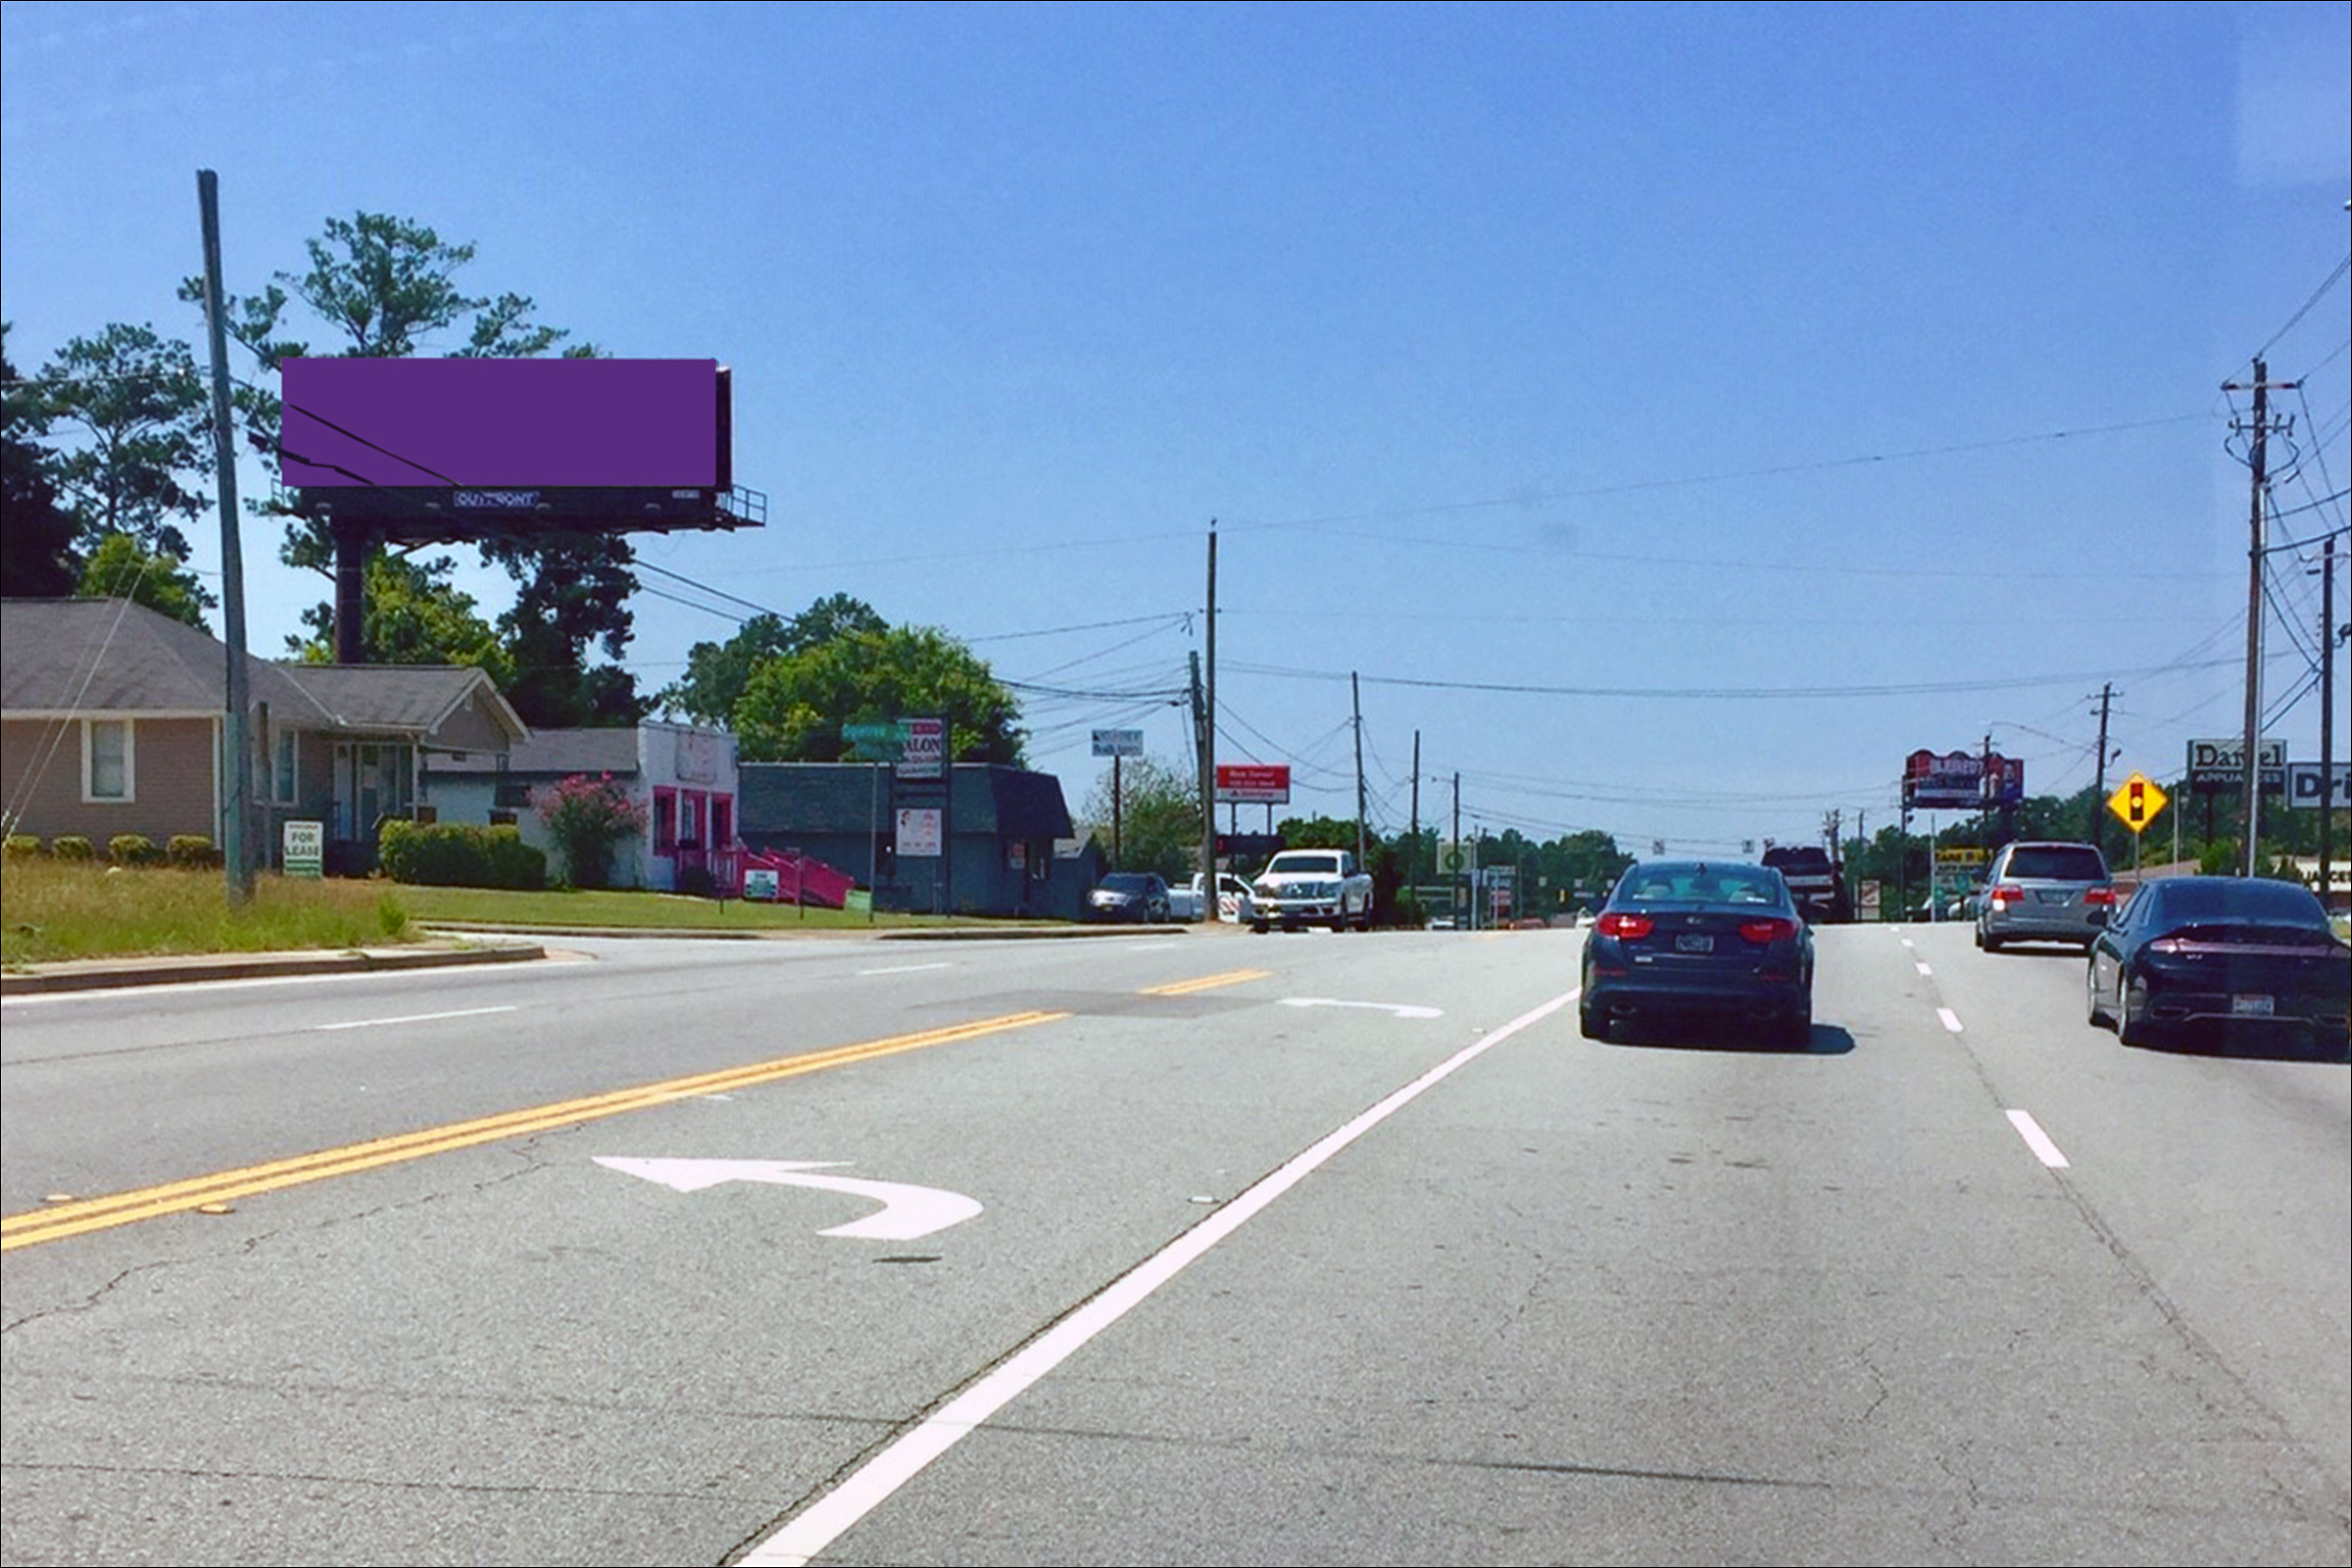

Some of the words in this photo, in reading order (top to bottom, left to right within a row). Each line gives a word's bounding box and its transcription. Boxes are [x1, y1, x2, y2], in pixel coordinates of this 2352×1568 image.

[904, 738, 941, 753] ALON
[2195, 744, 2282, 768] Danel
[2195, 772, 2282, 783] APPLIACES
[291, 832, 315, 843] FOR
[285, 845, 319, 857] LEASE
